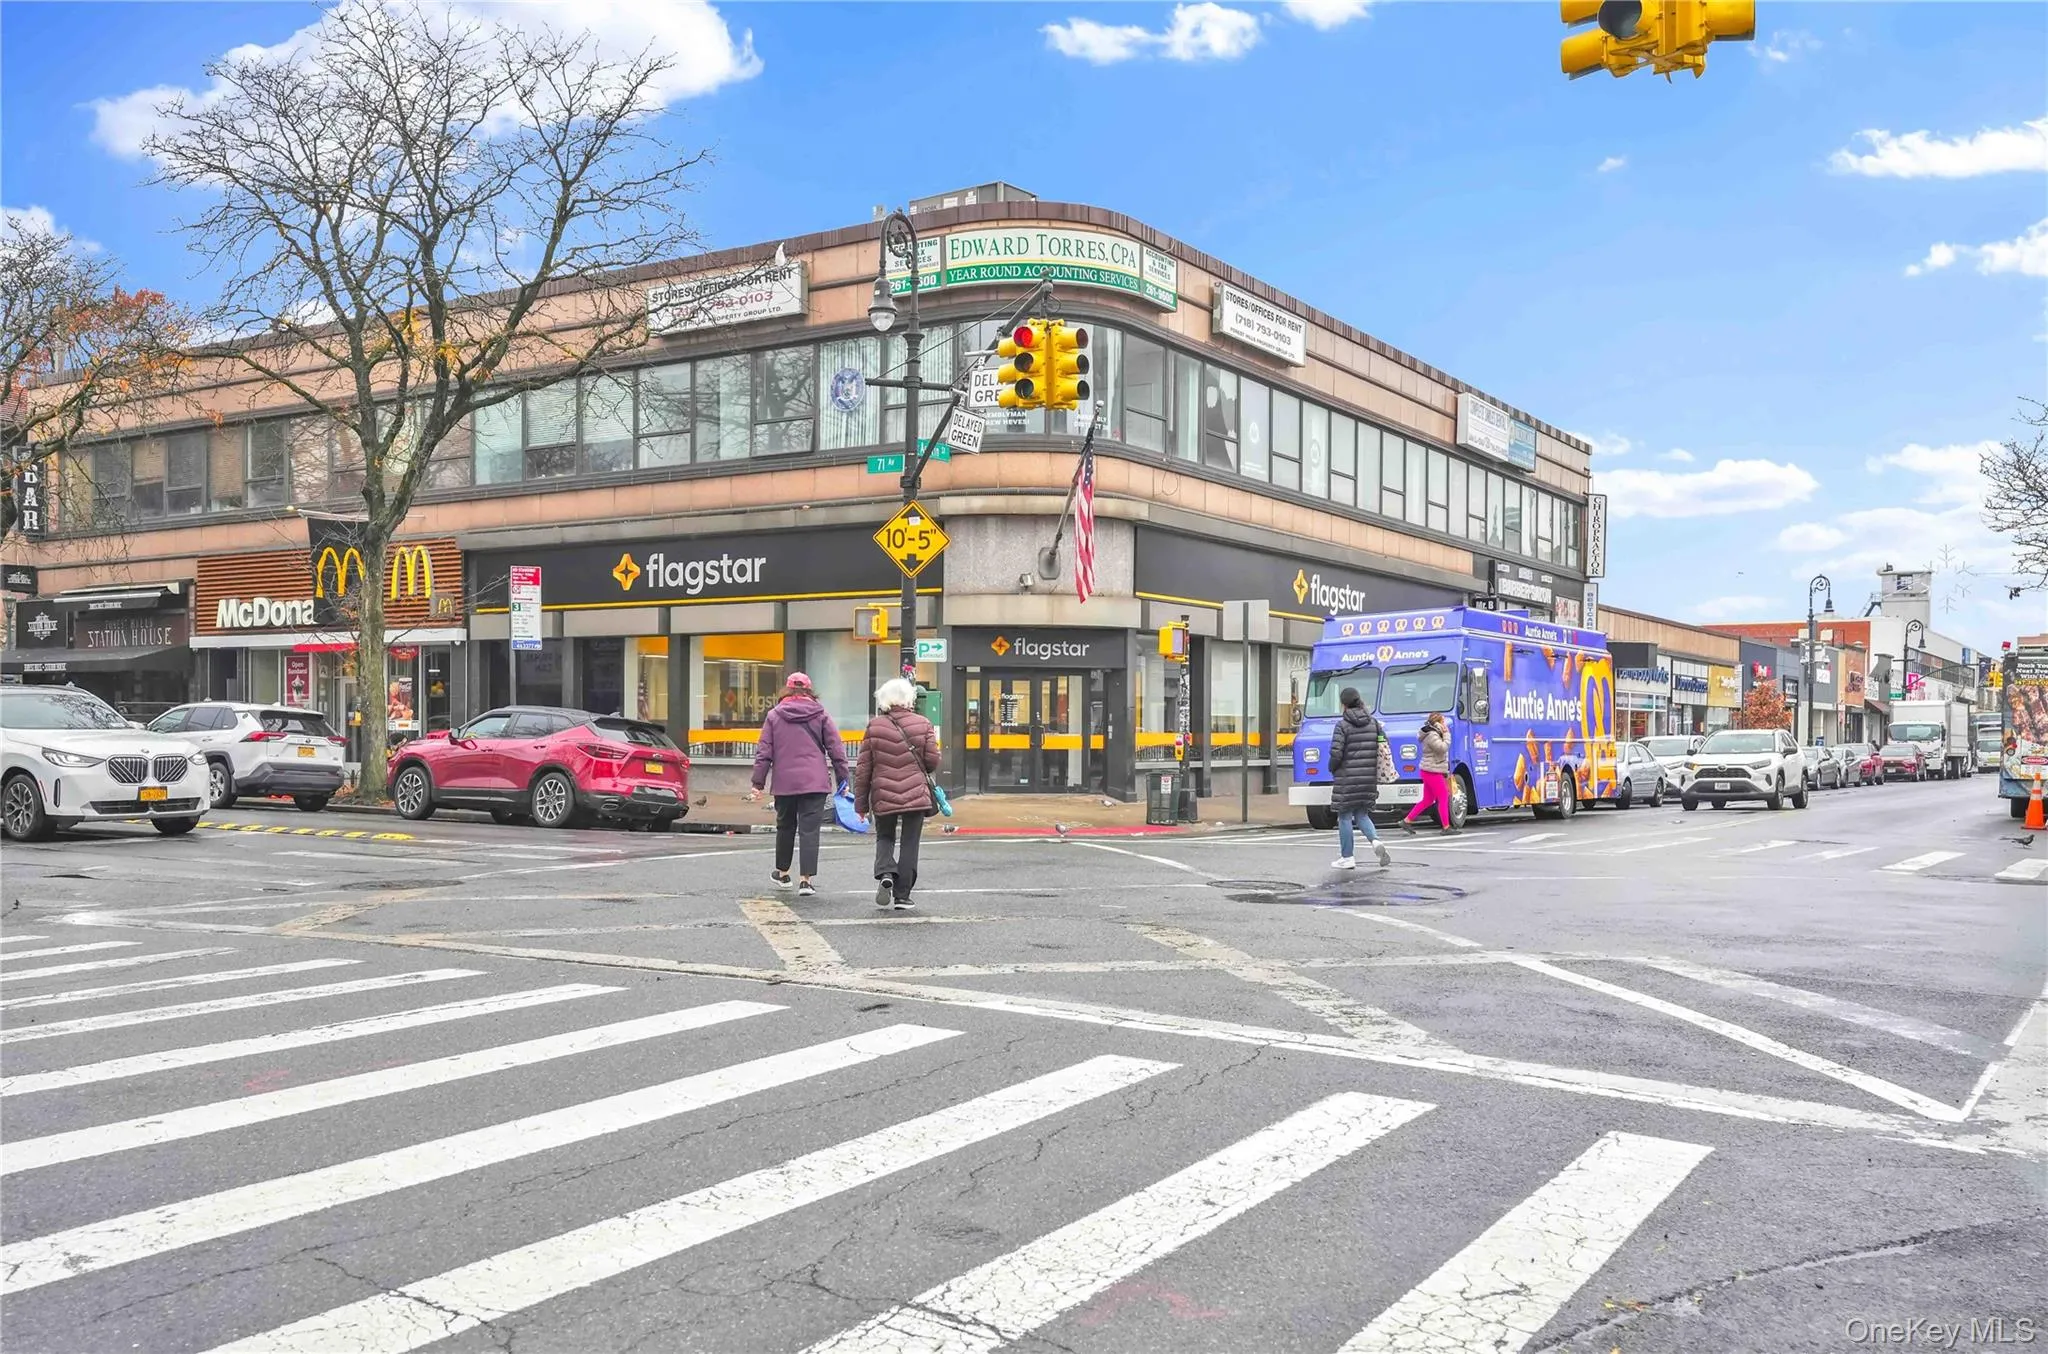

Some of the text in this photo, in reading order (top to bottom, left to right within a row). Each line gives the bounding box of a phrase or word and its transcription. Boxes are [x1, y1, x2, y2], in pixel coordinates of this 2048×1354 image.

[950, 233, 1137, 269] EDWARD TORRES, CPA
[765, 267, 793, 282] RENT
[890, 274, 937, 292] 261-600
[949, 268, 977, 282] YEAR
[980, 265, 1020, 278] ROUND
[1100, 272, 1138, 290] SERVICES
[743, 308, 766, 317] GROUP
[1235, 312, 1255, 331] (718)
[1275, 314, 1287, 328] FOR
[1287, 319, 1302, 334] RENT
[975, 389, 1000, 402] GRE
[953, 412, 983, 434] DELAYED
[951, 429, 980, 448] GREEN
[877, 458, 885, 468] 71
[1591, 496, 1601, 575] CHIROPRACTOR
[646, 553, 767, 595] flagstar
[1310, 573, 1366, 616] flagstar
[216, 597, 315, 628] McDona
[88, 627, 172, 648] STATION HOUSE
[1525, 624, 1557, 641] Auntie Anne's
[1013, 636, 1090, 660] flagstar
[1341, 649, 1430, 663] Auntie Anne's
[1504, 689, 1582, 722] Auntie Anne's
